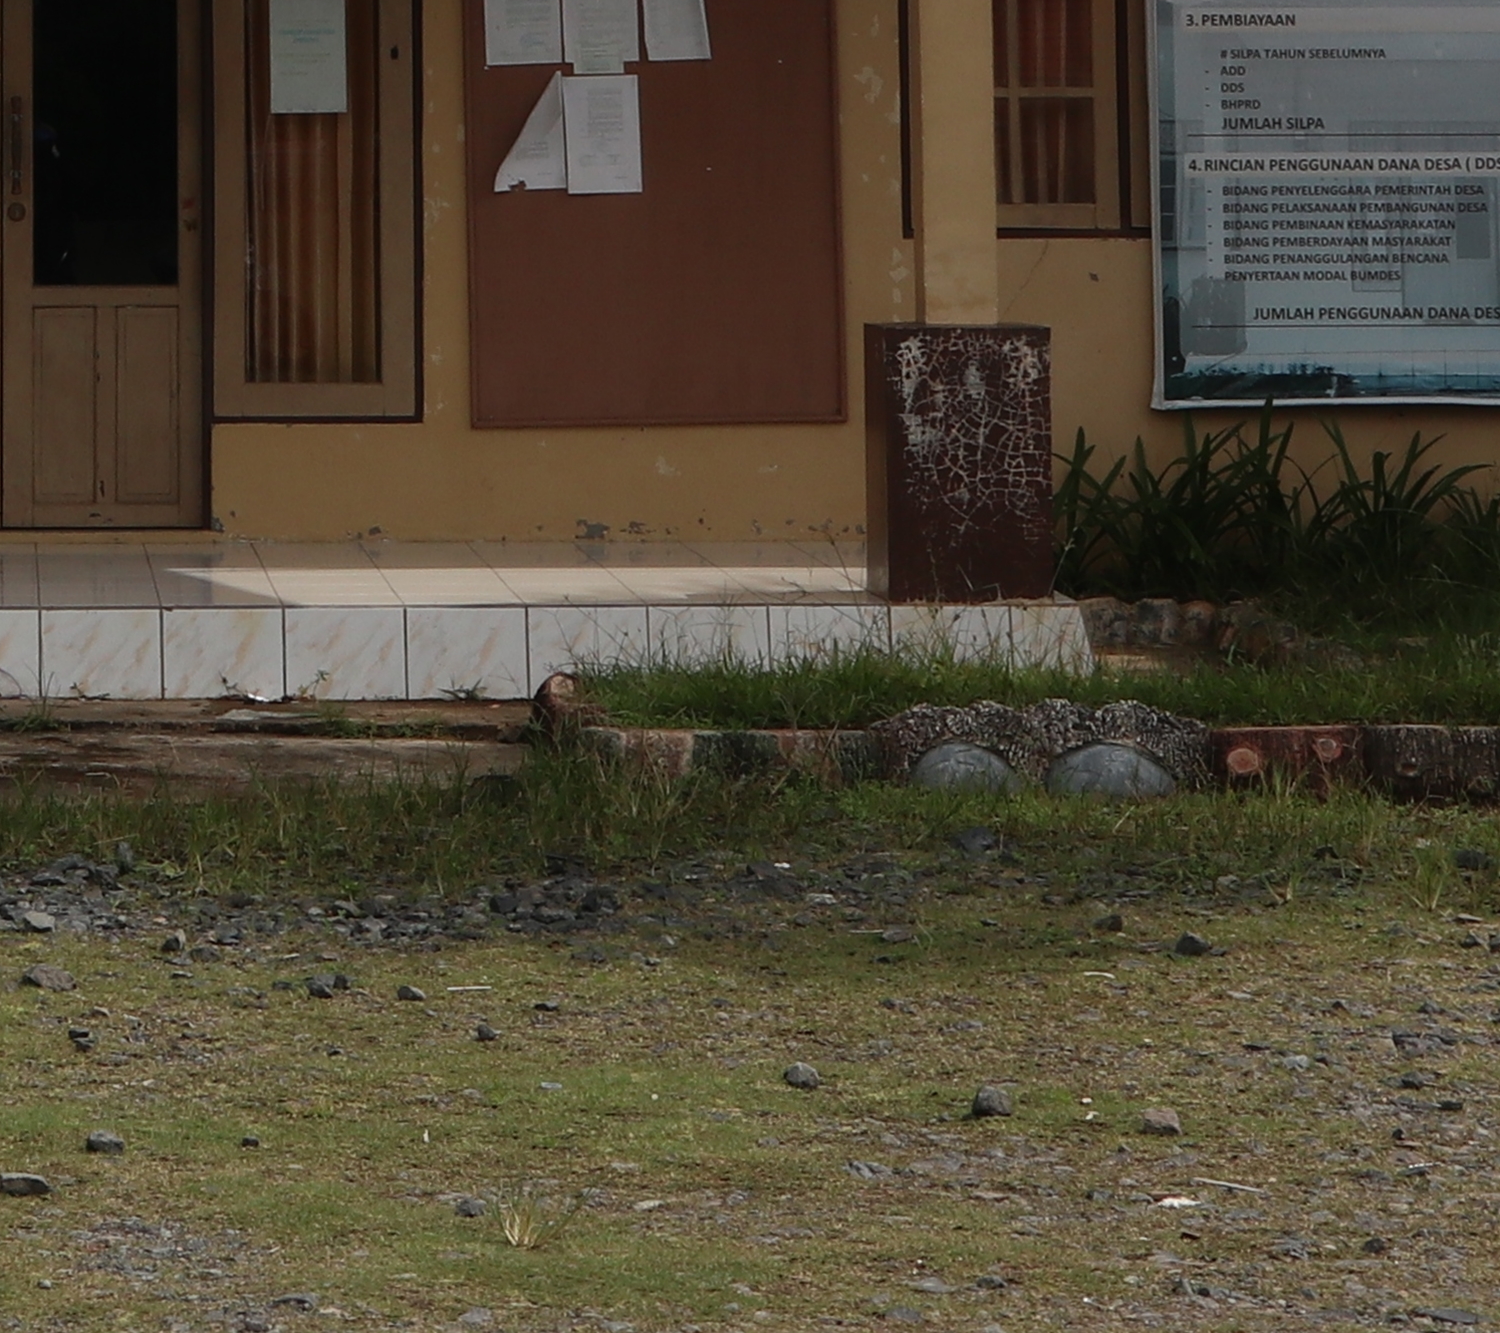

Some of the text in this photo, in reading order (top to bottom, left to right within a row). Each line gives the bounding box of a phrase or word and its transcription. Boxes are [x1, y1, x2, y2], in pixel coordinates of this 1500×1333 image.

[1201, 14, 1296, 27] PEMBIAYAAN
[1204, 159, 1265, 171] RINCIAN
[1269, 159, 1374, 171] PENGGUNAAN
[1378, 159, 1421, 171] DANA
[1428, 159, 1462, 171] DESA
[1254, 307, 1471, 320] JUMLAH PENGGUNAAN DANA
